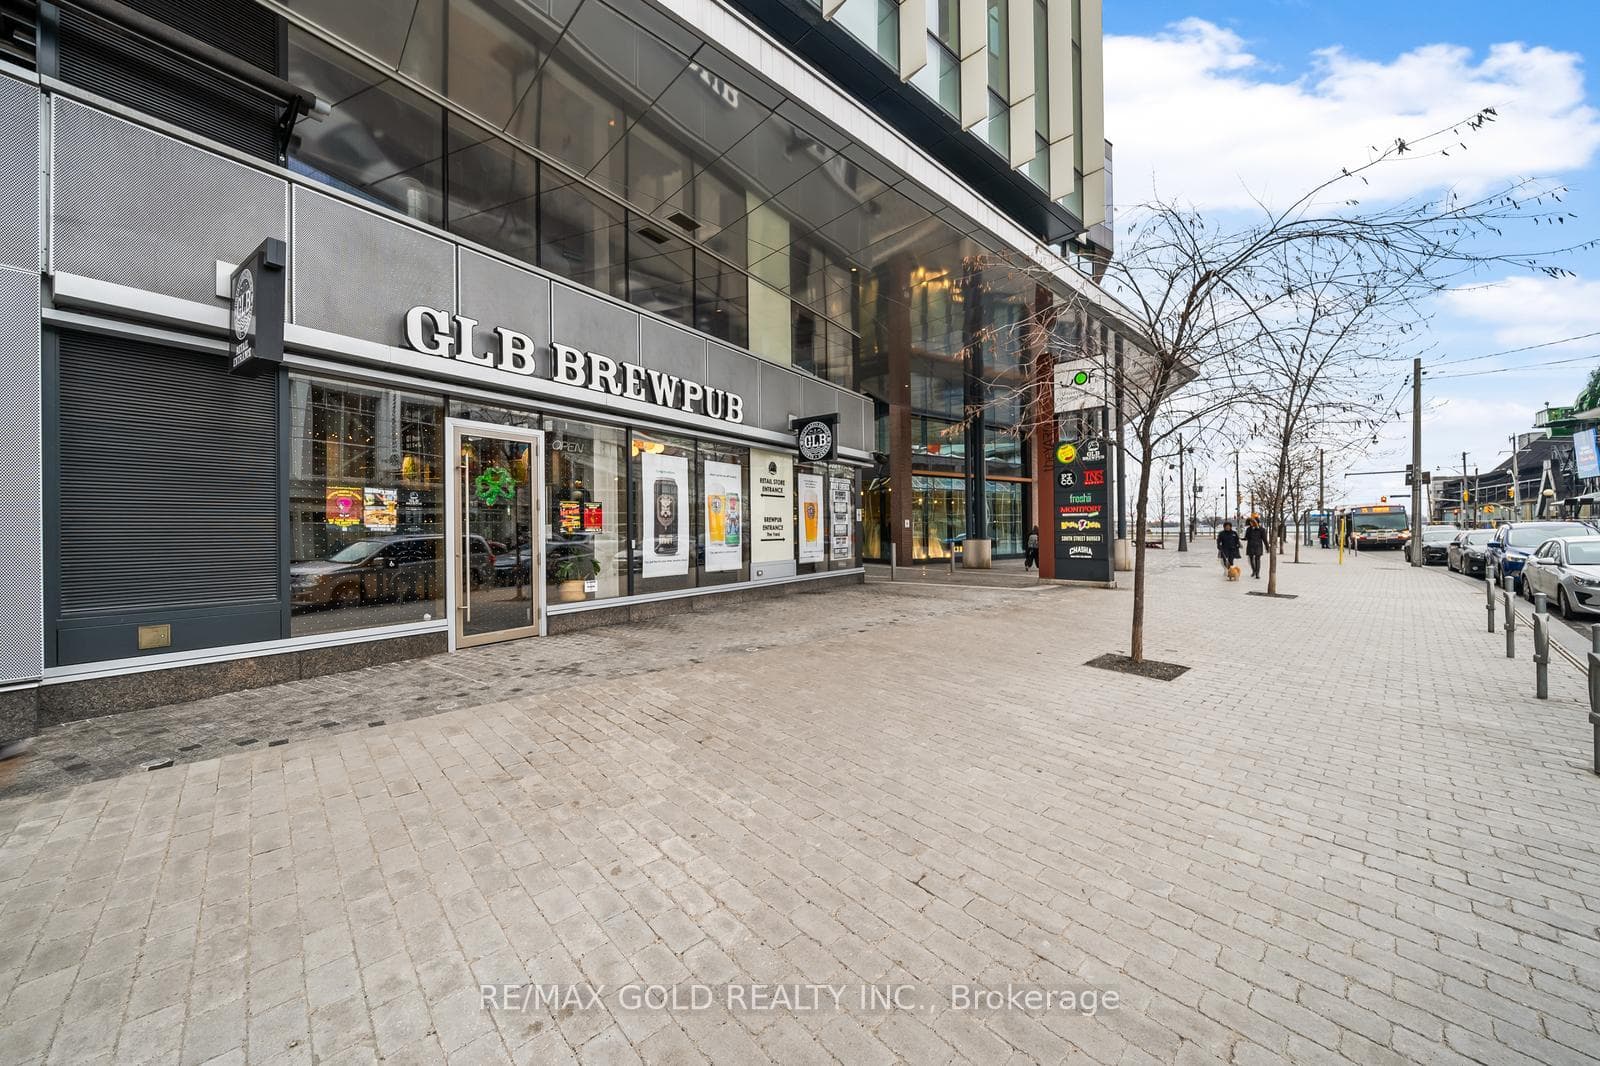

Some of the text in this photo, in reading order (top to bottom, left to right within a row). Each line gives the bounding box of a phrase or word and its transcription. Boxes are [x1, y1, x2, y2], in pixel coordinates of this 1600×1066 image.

[237, 291, 251, 319] GLB
[404, 304, 745, 425] GLB BREWPUB
[551, 439, 585, 454] OPEN
[804, 433, 827, 448] GLB
[759, 477, 786, 486] RETAIL STORE
[1060, 505, 1102, 513] MONTFORT
